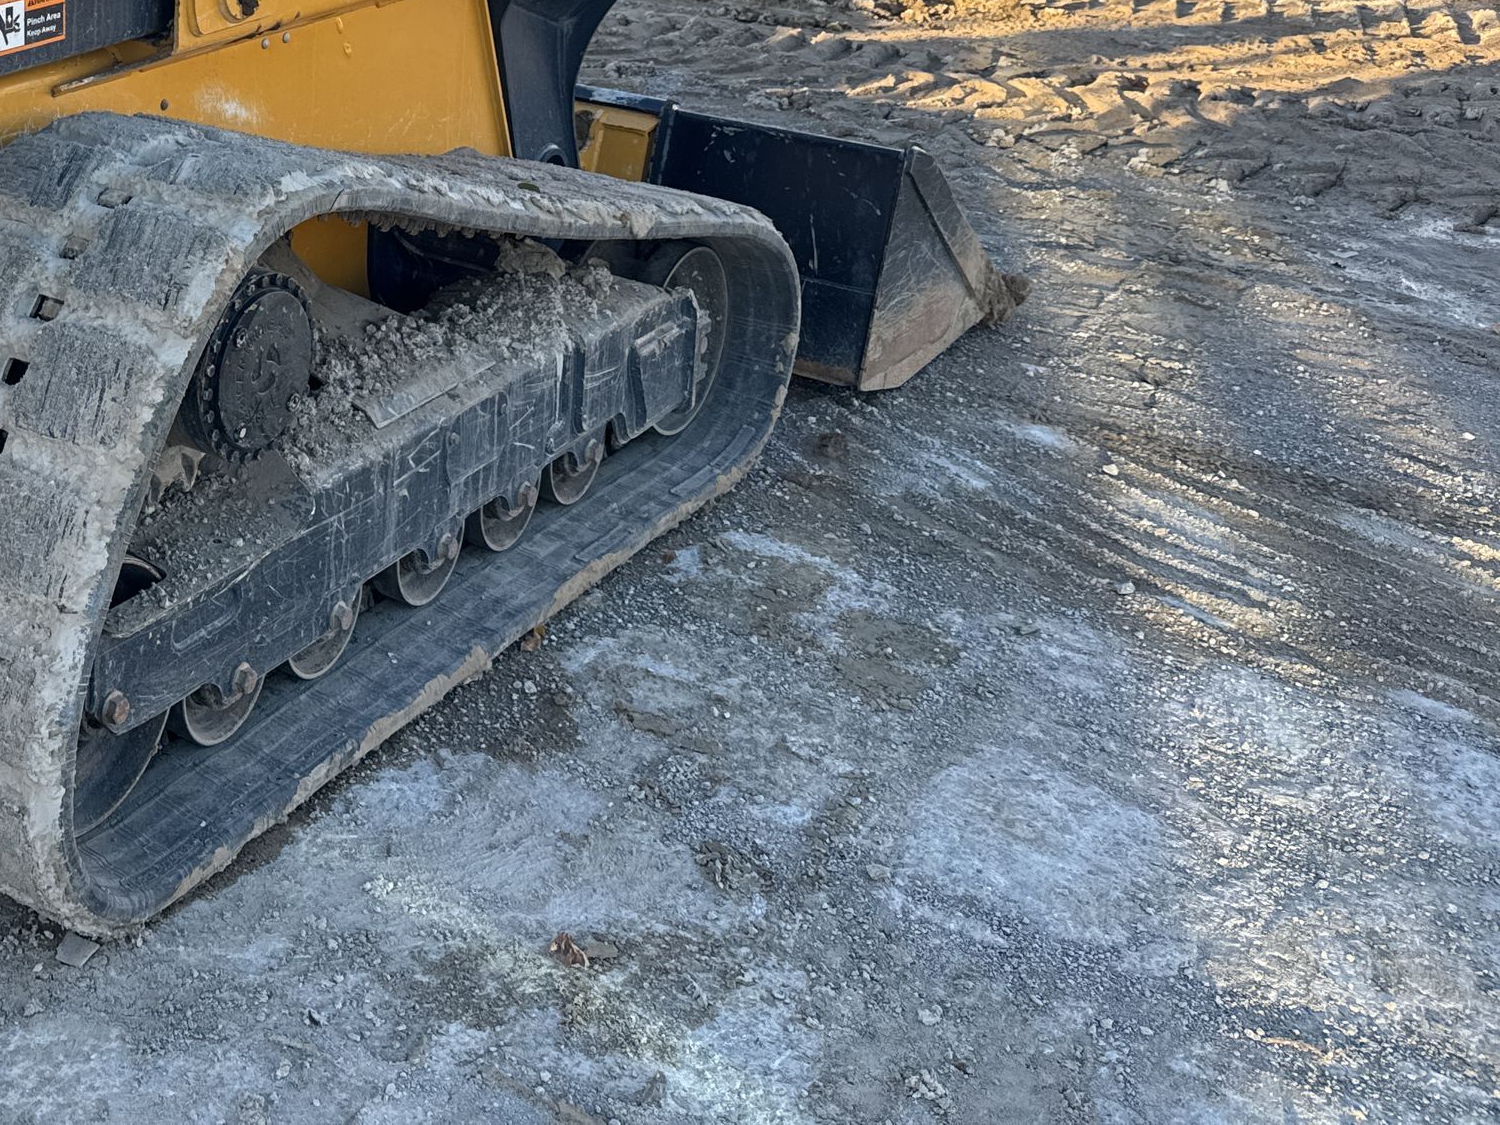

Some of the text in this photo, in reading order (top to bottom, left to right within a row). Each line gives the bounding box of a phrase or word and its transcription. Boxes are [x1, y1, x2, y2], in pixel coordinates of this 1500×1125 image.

[26, 10, 61, 27] Pinch Area
[26, 24, 57, 38] Keep Away
